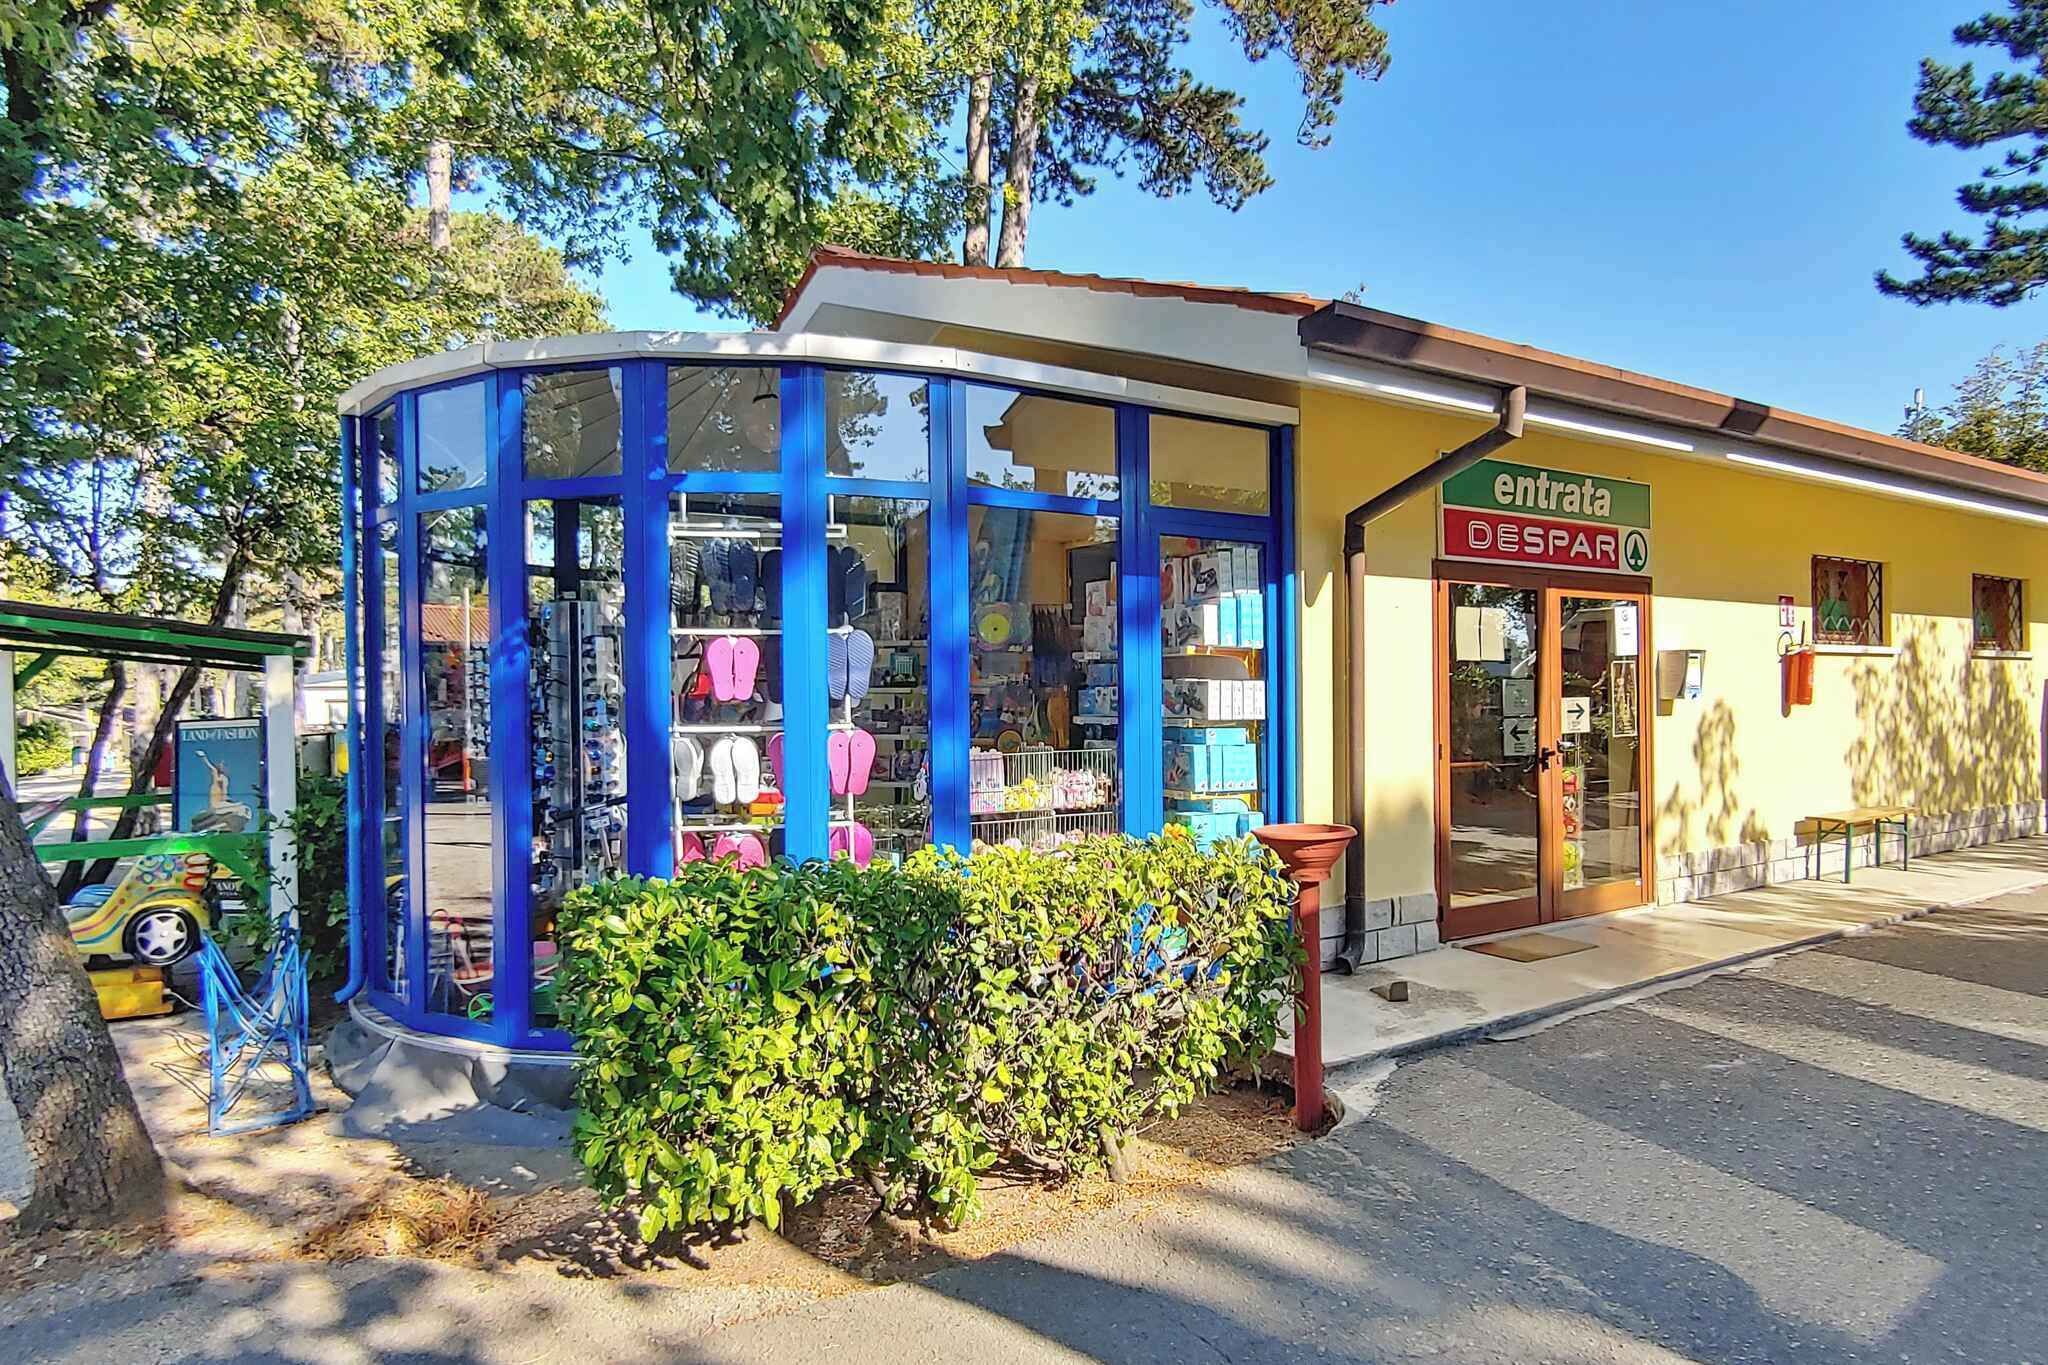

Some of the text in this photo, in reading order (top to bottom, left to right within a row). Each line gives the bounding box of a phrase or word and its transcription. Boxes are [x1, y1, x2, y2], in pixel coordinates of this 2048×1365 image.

[1494, 472, 1612, 516] entrata
[1468, 521, 1615, 562] DESPAR
[182, 729, 209, 741] LAND
[216, 728, 258, 740] FASHION
